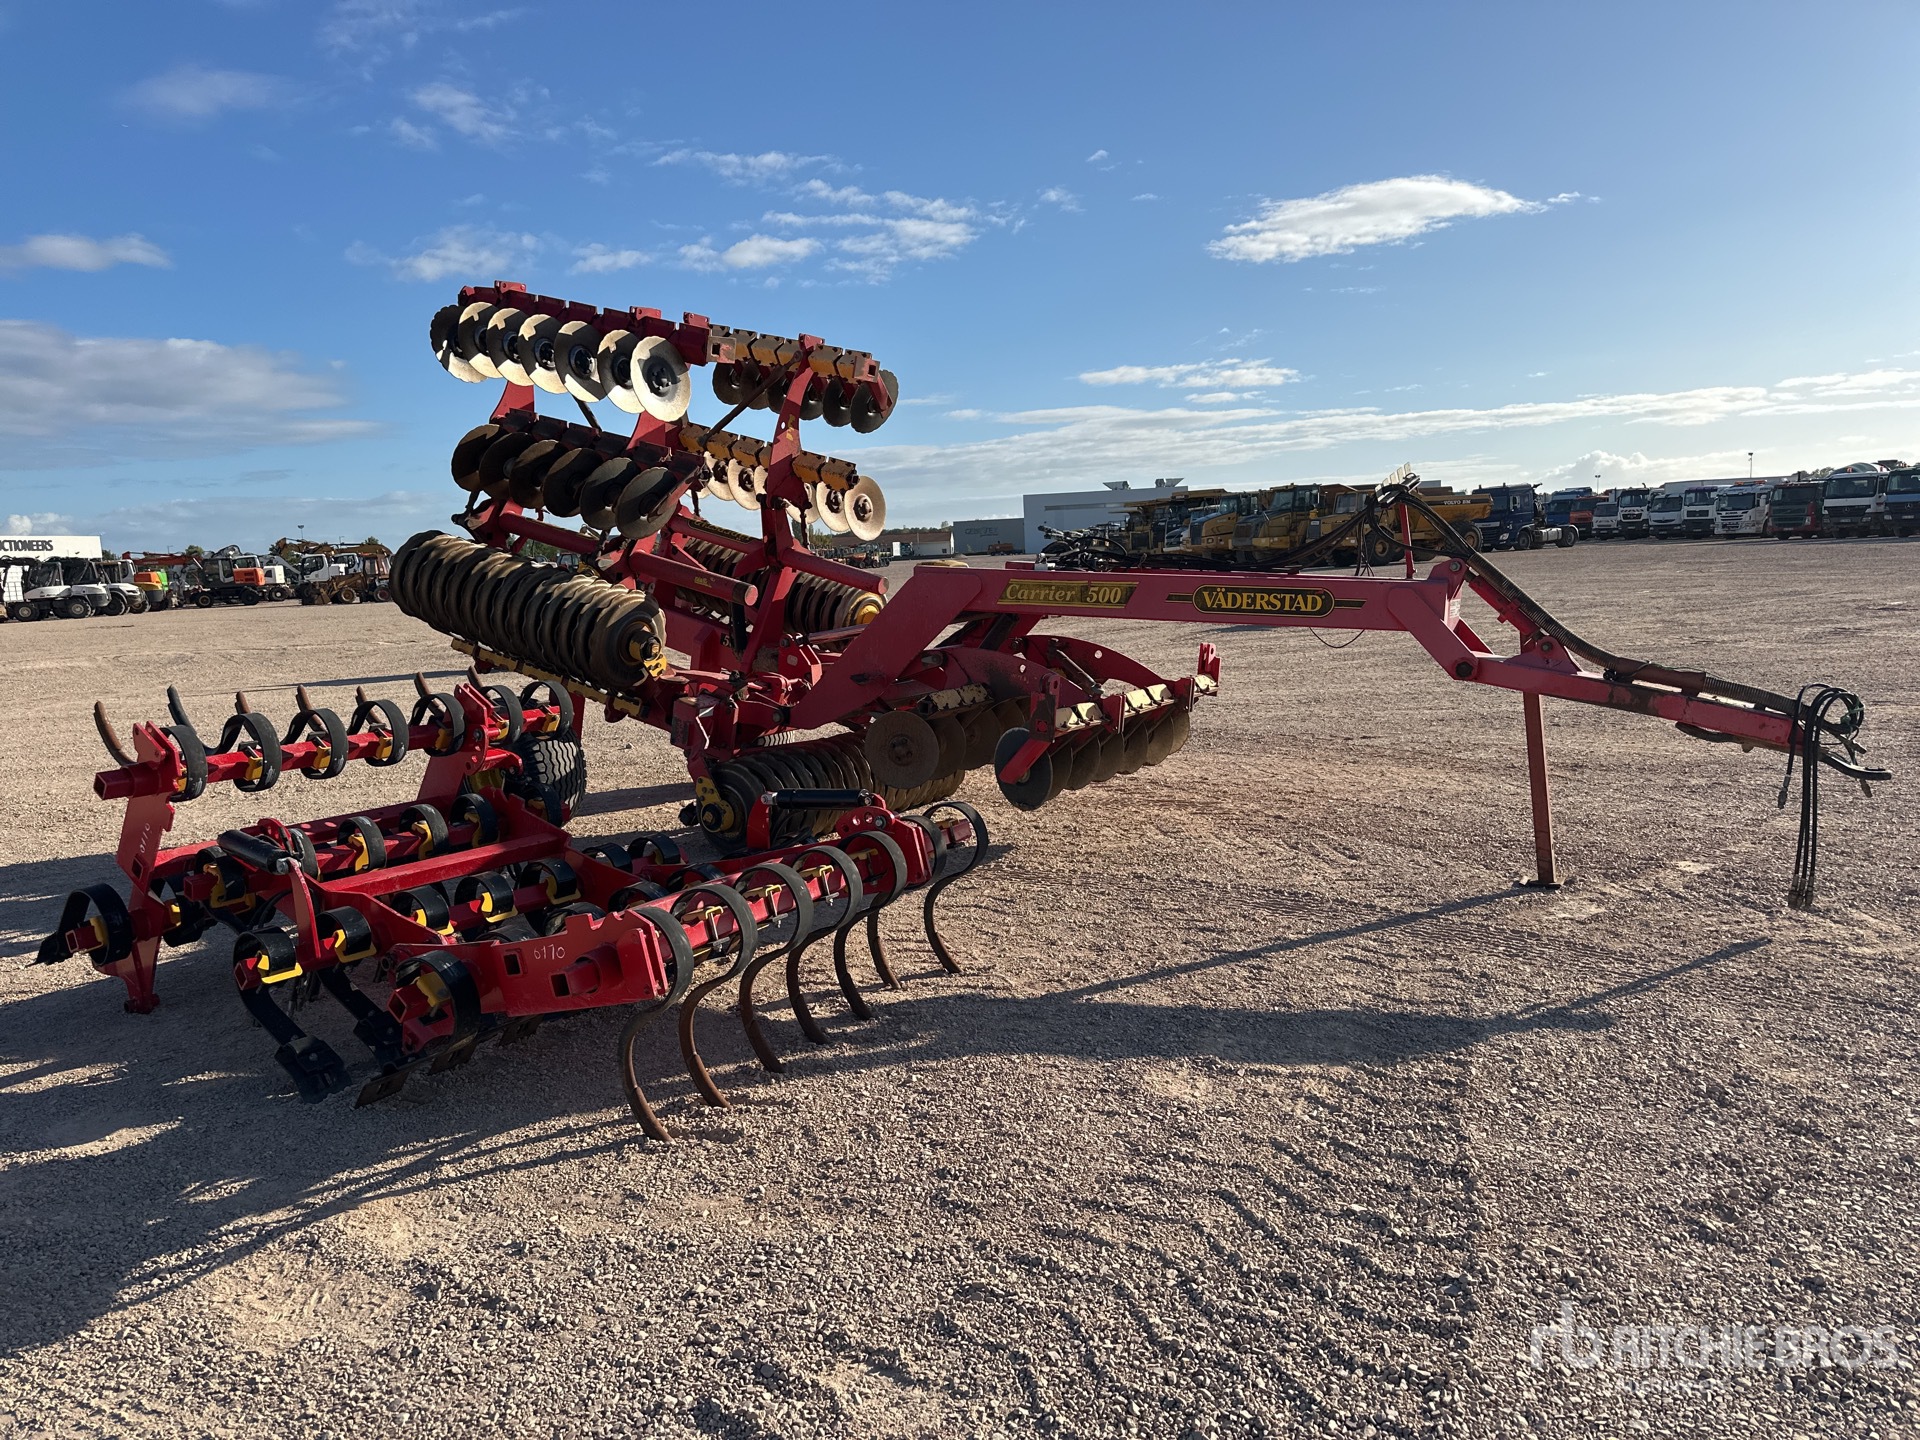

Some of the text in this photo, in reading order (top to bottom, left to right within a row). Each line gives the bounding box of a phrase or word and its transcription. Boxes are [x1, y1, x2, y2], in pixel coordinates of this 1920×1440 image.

[0, 540, 53, 551] CTIONEERS
[1006, 584, 1121, 603] Carrier 500
[1202, 587, 1323, 612] VÄDERSTAD
